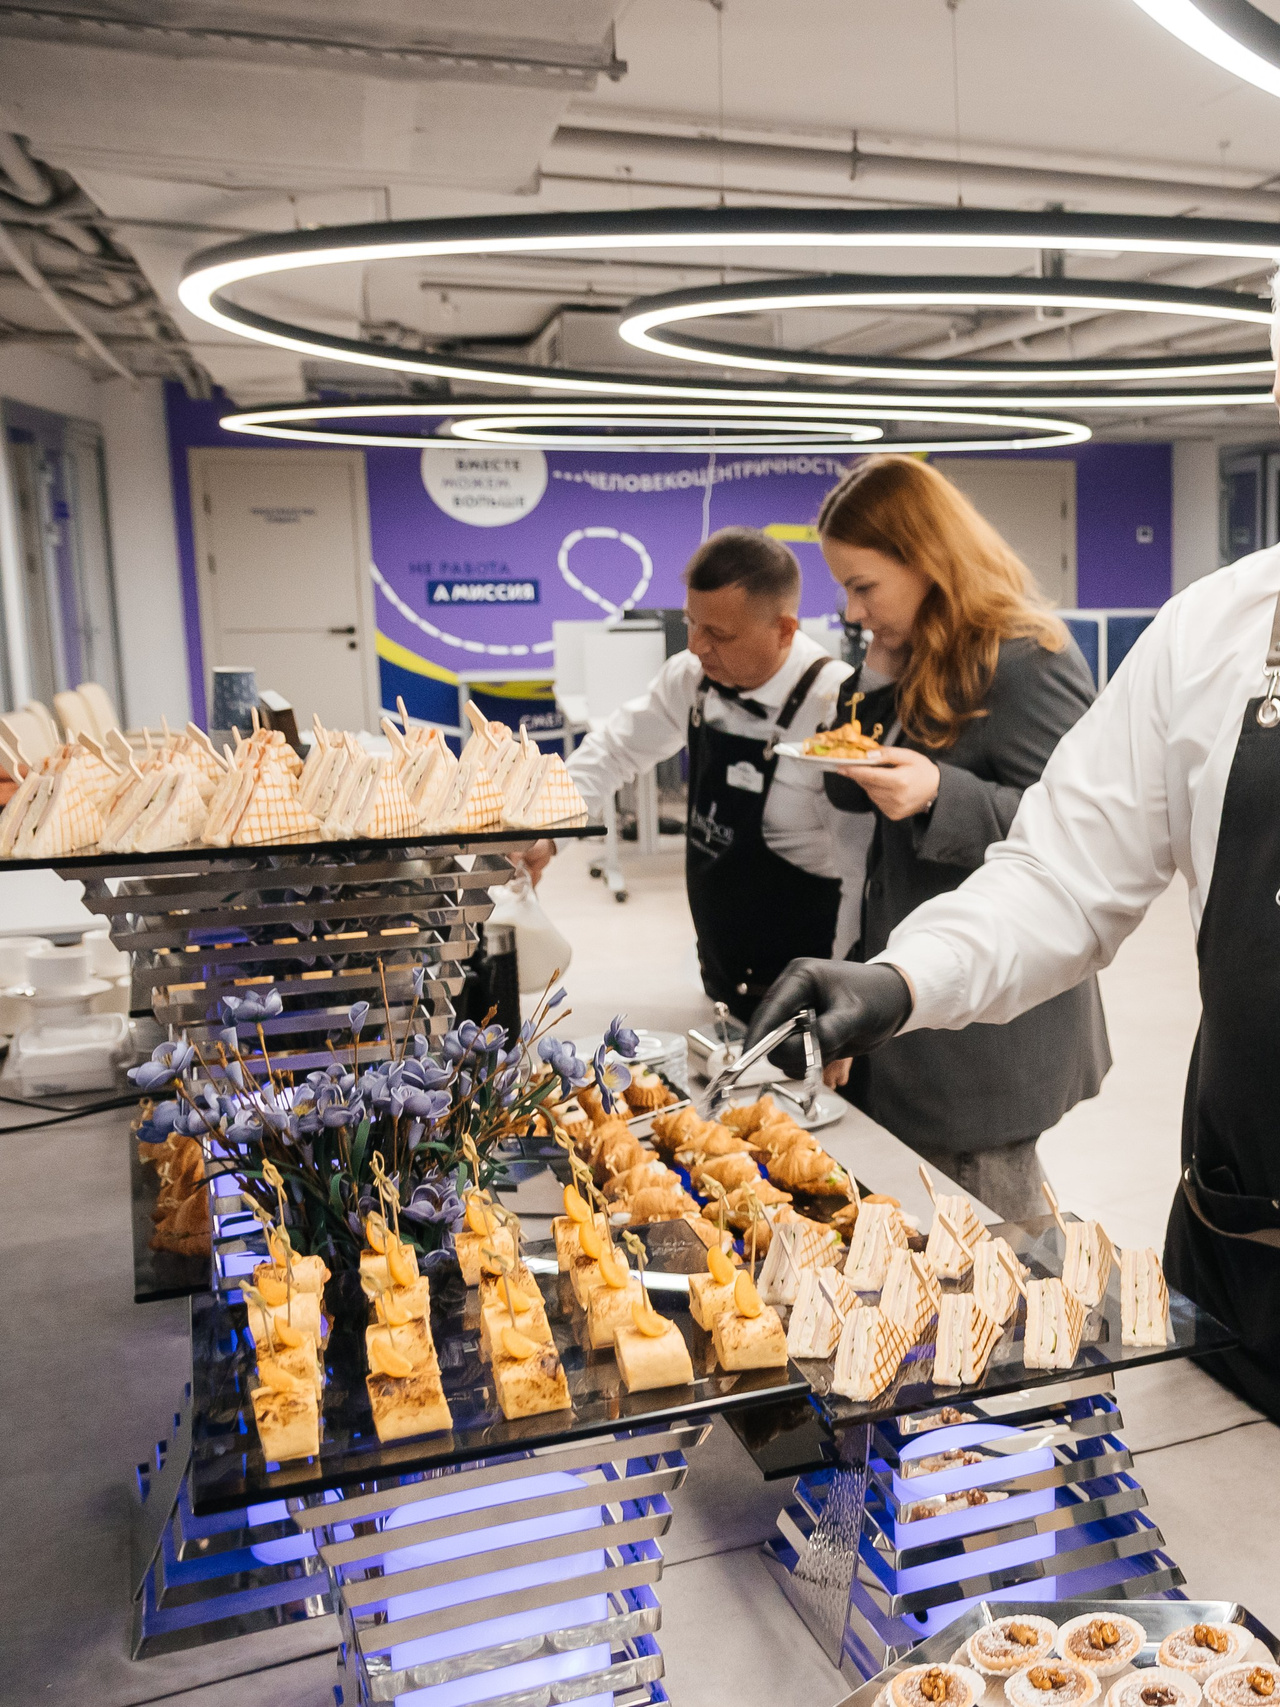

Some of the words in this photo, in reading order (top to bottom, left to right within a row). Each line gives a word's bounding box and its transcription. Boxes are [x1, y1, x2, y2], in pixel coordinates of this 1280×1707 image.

[455, 458, 520, 472] ВМЕСТЕ
[408, 561, 431, 575] НЕ
[432, 582, 451, 602] А
[451, 582, 536, 602] МИССИЯ
